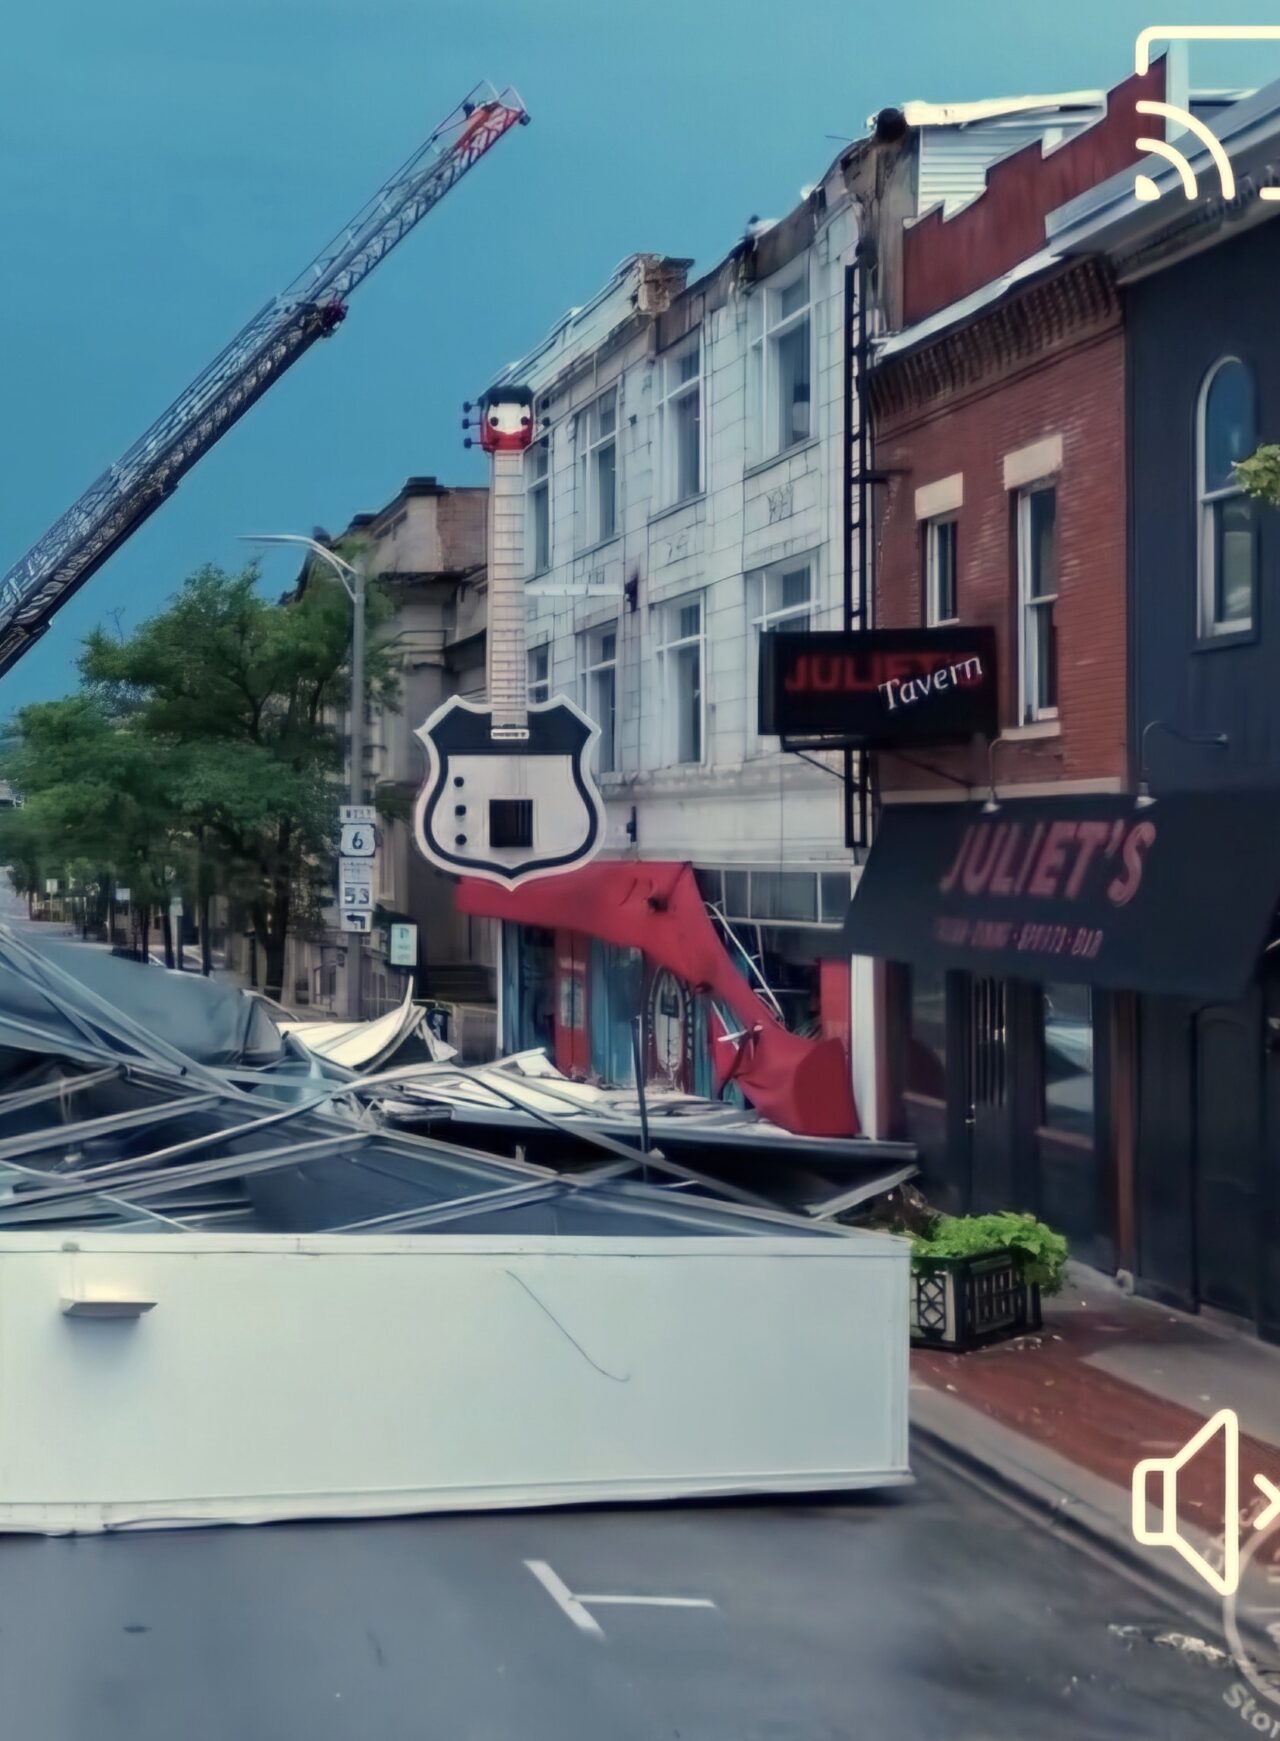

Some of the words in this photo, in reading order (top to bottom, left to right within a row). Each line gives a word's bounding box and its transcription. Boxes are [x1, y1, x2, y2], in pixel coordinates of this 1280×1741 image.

[878, 656, 983, 710] Tavern
[351, 831, 364, 850] 6
[939, 819, 1157, 907] JULIET'S
